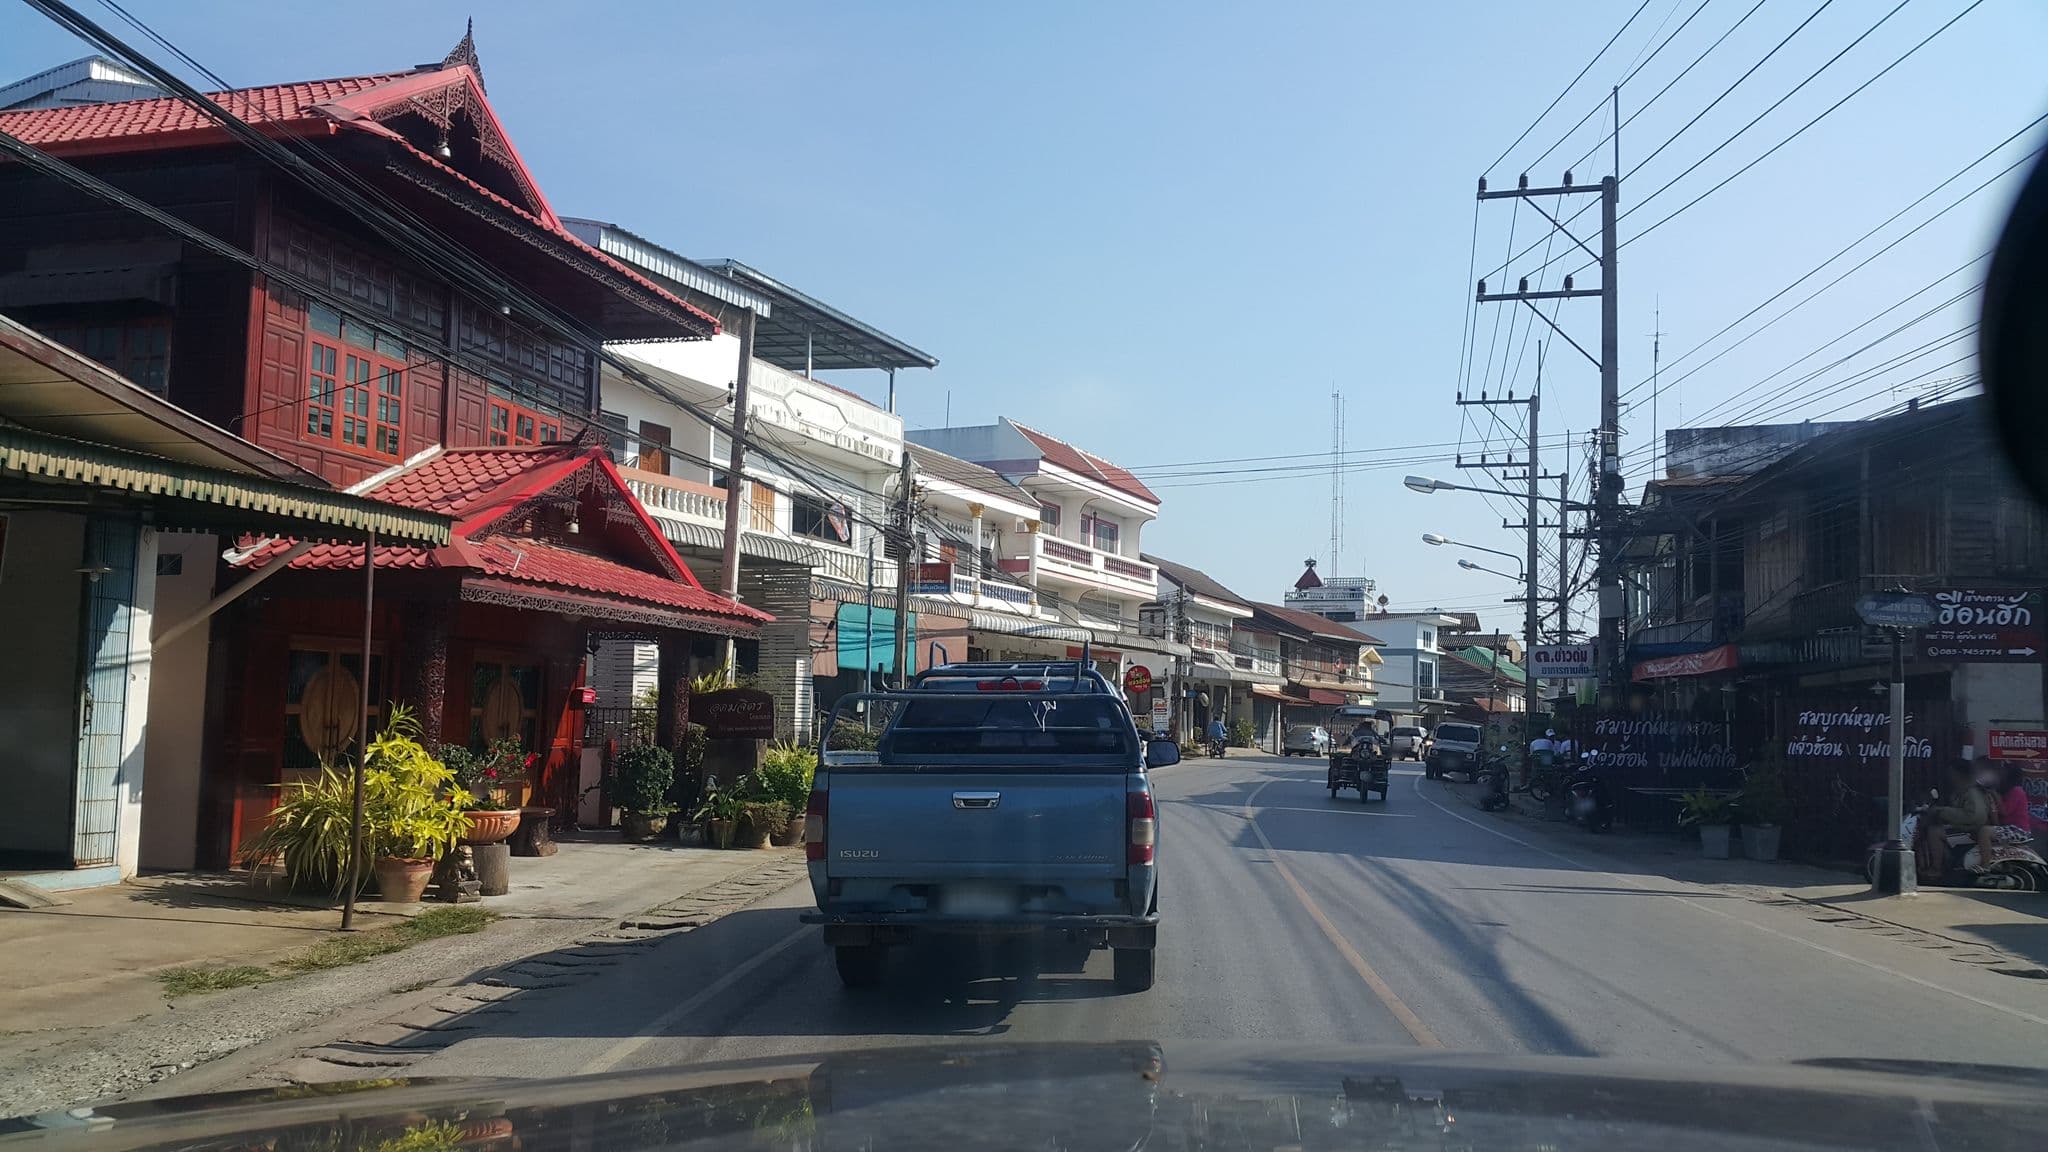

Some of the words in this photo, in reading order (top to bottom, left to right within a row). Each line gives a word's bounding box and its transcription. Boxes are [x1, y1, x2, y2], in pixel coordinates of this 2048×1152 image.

[1932, 590, 2032, 626] ฮือนฮัก
[840, 850, 879, 858] ISUZU
